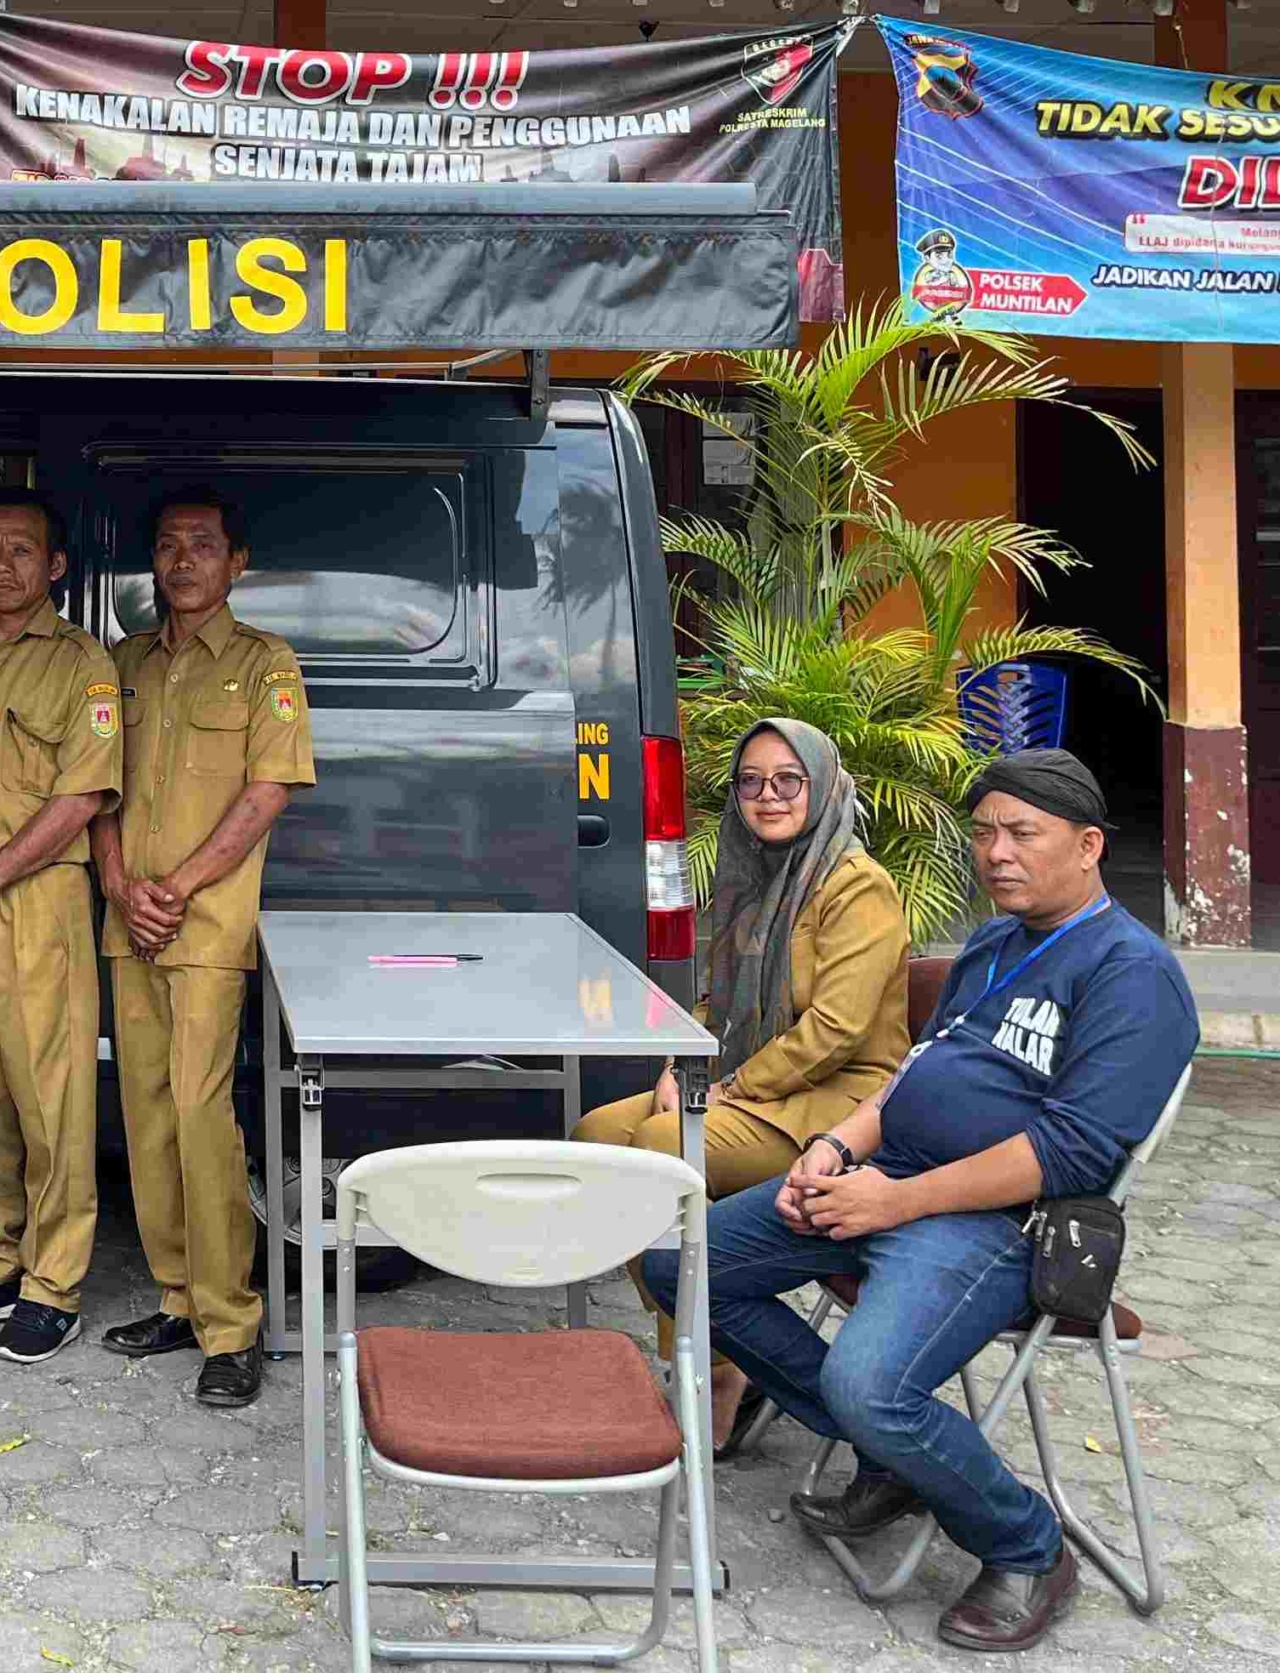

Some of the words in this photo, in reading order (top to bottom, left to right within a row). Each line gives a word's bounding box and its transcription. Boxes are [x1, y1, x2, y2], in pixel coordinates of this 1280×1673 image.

[175, 40, 411, 105] STOP
[429, 51, 529, 111] !!!
[16, 84, 215, 133] KENAKALAN
[224, 105, 360, 143] REMAJA
[369, 112, 441, 147] DAN
[448, 105, 692, 146] PENGGUNAAN
[719, 118, 769, 133] POLRESTA
[770, 118, 826, 129] MAGELANG
[737, 107, 807, 122] SATRESKRIM
[1037, 102, 1167, 134] TIDAK
[215, 146, 358, 182] SENJATA
[366, 151, 483, 183] TAJAM
[980, 273, 1042, 292] POLSEK
[1093, 266, 1191, 289] JADIKAN
[1195, 271, 1274, 291] JALAN
[981, 293, 1073, 313] MUNTILAN
